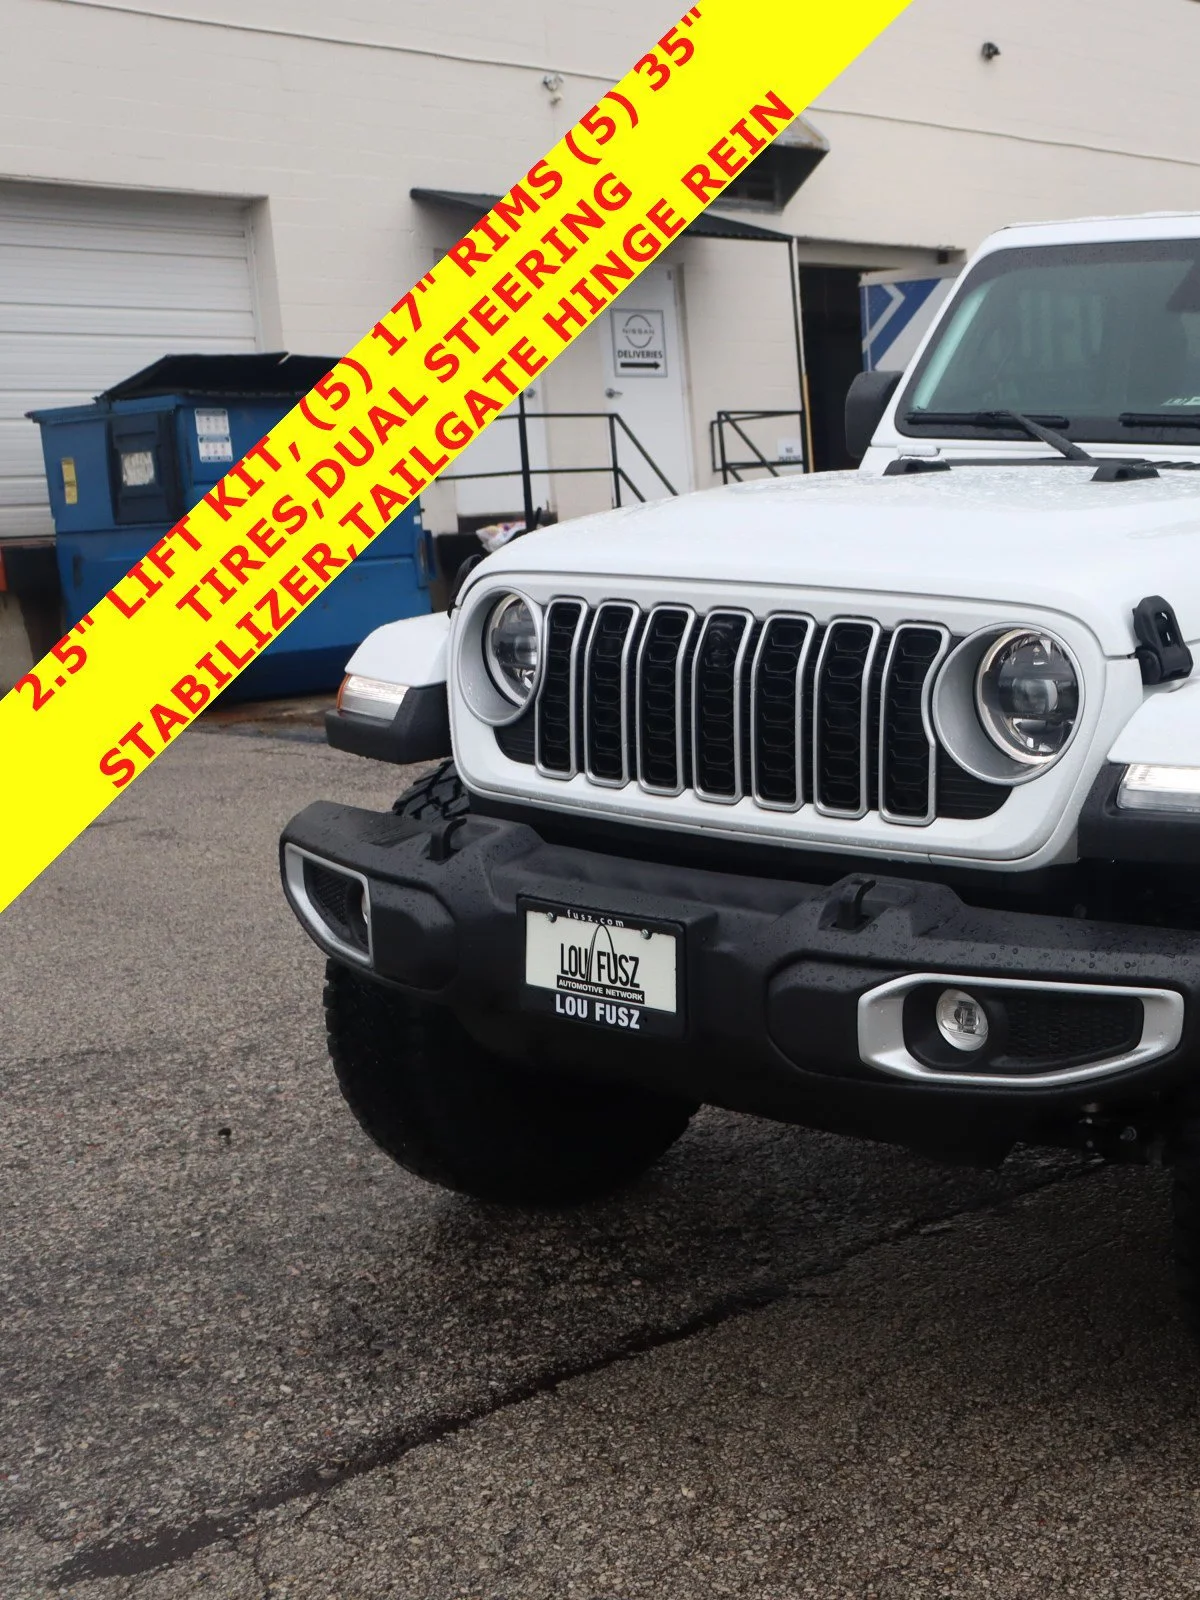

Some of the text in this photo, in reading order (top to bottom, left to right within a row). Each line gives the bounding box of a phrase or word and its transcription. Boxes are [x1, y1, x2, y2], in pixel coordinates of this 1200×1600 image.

[617, 350, 663, 359] DELIVERIES
[566, 909, 625, 928] fusz.com
[561, 943, 640, 988] LOU FUSZ
[558, 980, 643, 1001] AUTOMOTIVE NETWORK
[555, 994, 640, 1029] LOU FUSZ
